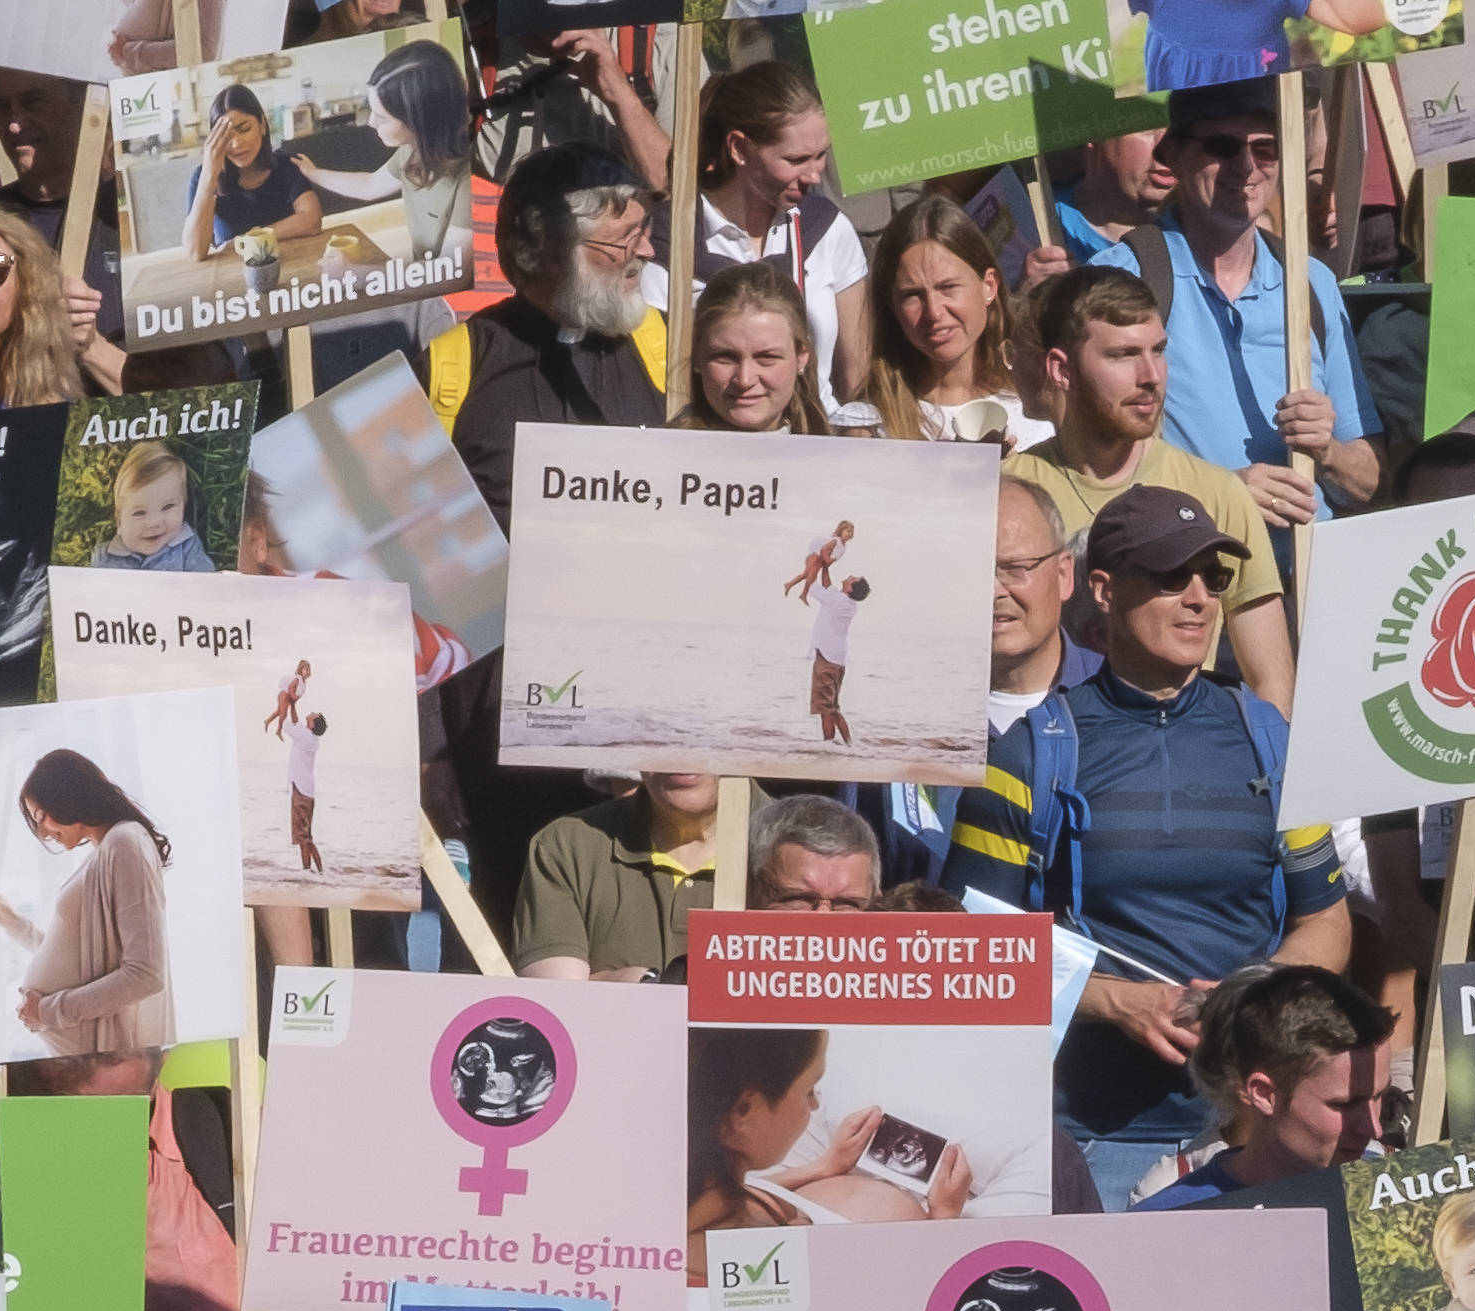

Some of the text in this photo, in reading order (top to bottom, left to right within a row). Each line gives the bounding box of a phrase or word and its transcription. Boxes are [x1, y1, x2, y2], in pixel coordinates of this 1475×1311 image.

[930, 0, 1067, 53] stehen
[858, 56, 1049, 131] zu ihrem
[135, 246, 463, 339] Du bist nicht allein!
[79, 399, 243, 448] Auch ich!
[1372, 529, 1466, 671] THANK
[74, 612, 252, 655] Danke, Papa!
[706, 930, 1035, 964] ABTREIBUNG TÖTET EIN
[727, 970, 1016, 1001] UNGEBORENES KIND
